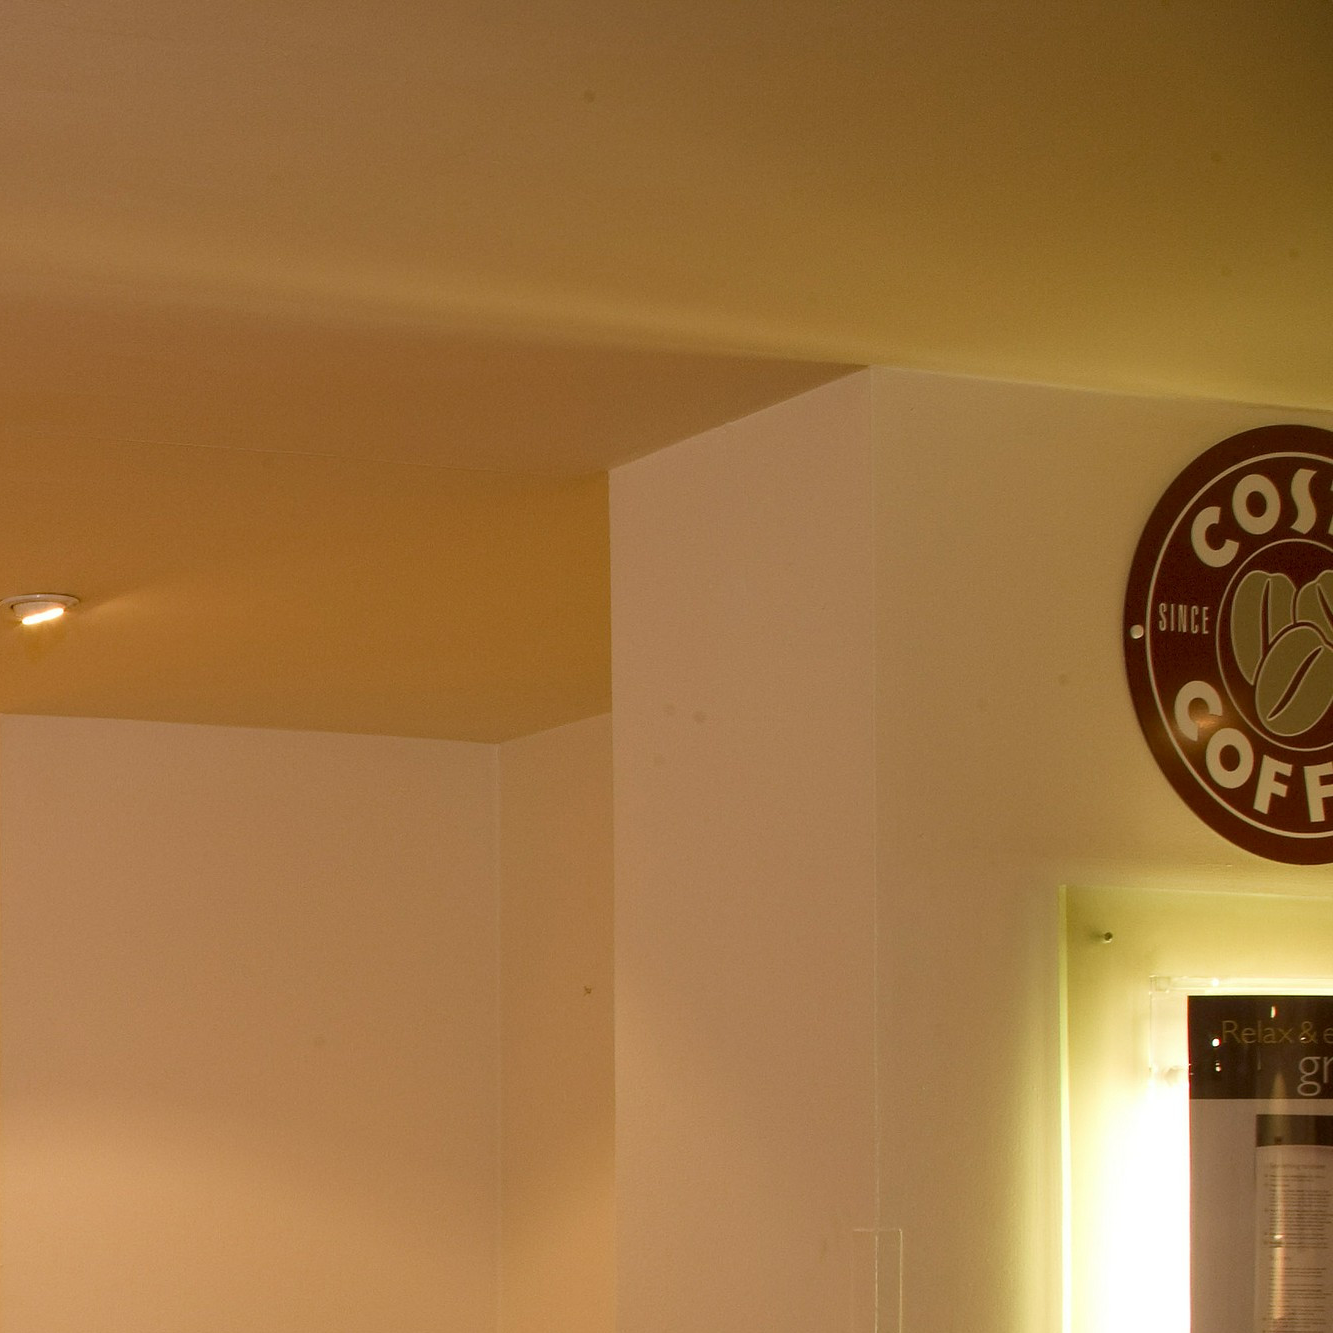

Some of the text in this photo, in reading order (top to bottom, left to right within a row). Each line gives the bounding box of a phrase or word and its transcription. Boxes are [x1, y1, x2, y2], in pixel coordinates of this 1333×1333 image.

[1191, 468, 1333, 568] COS
[1158, 603, 1210, 635] SINCE
[1221, 1020, 1294, 1044] Relax
[1299, 1021, 1319, 1044] &
